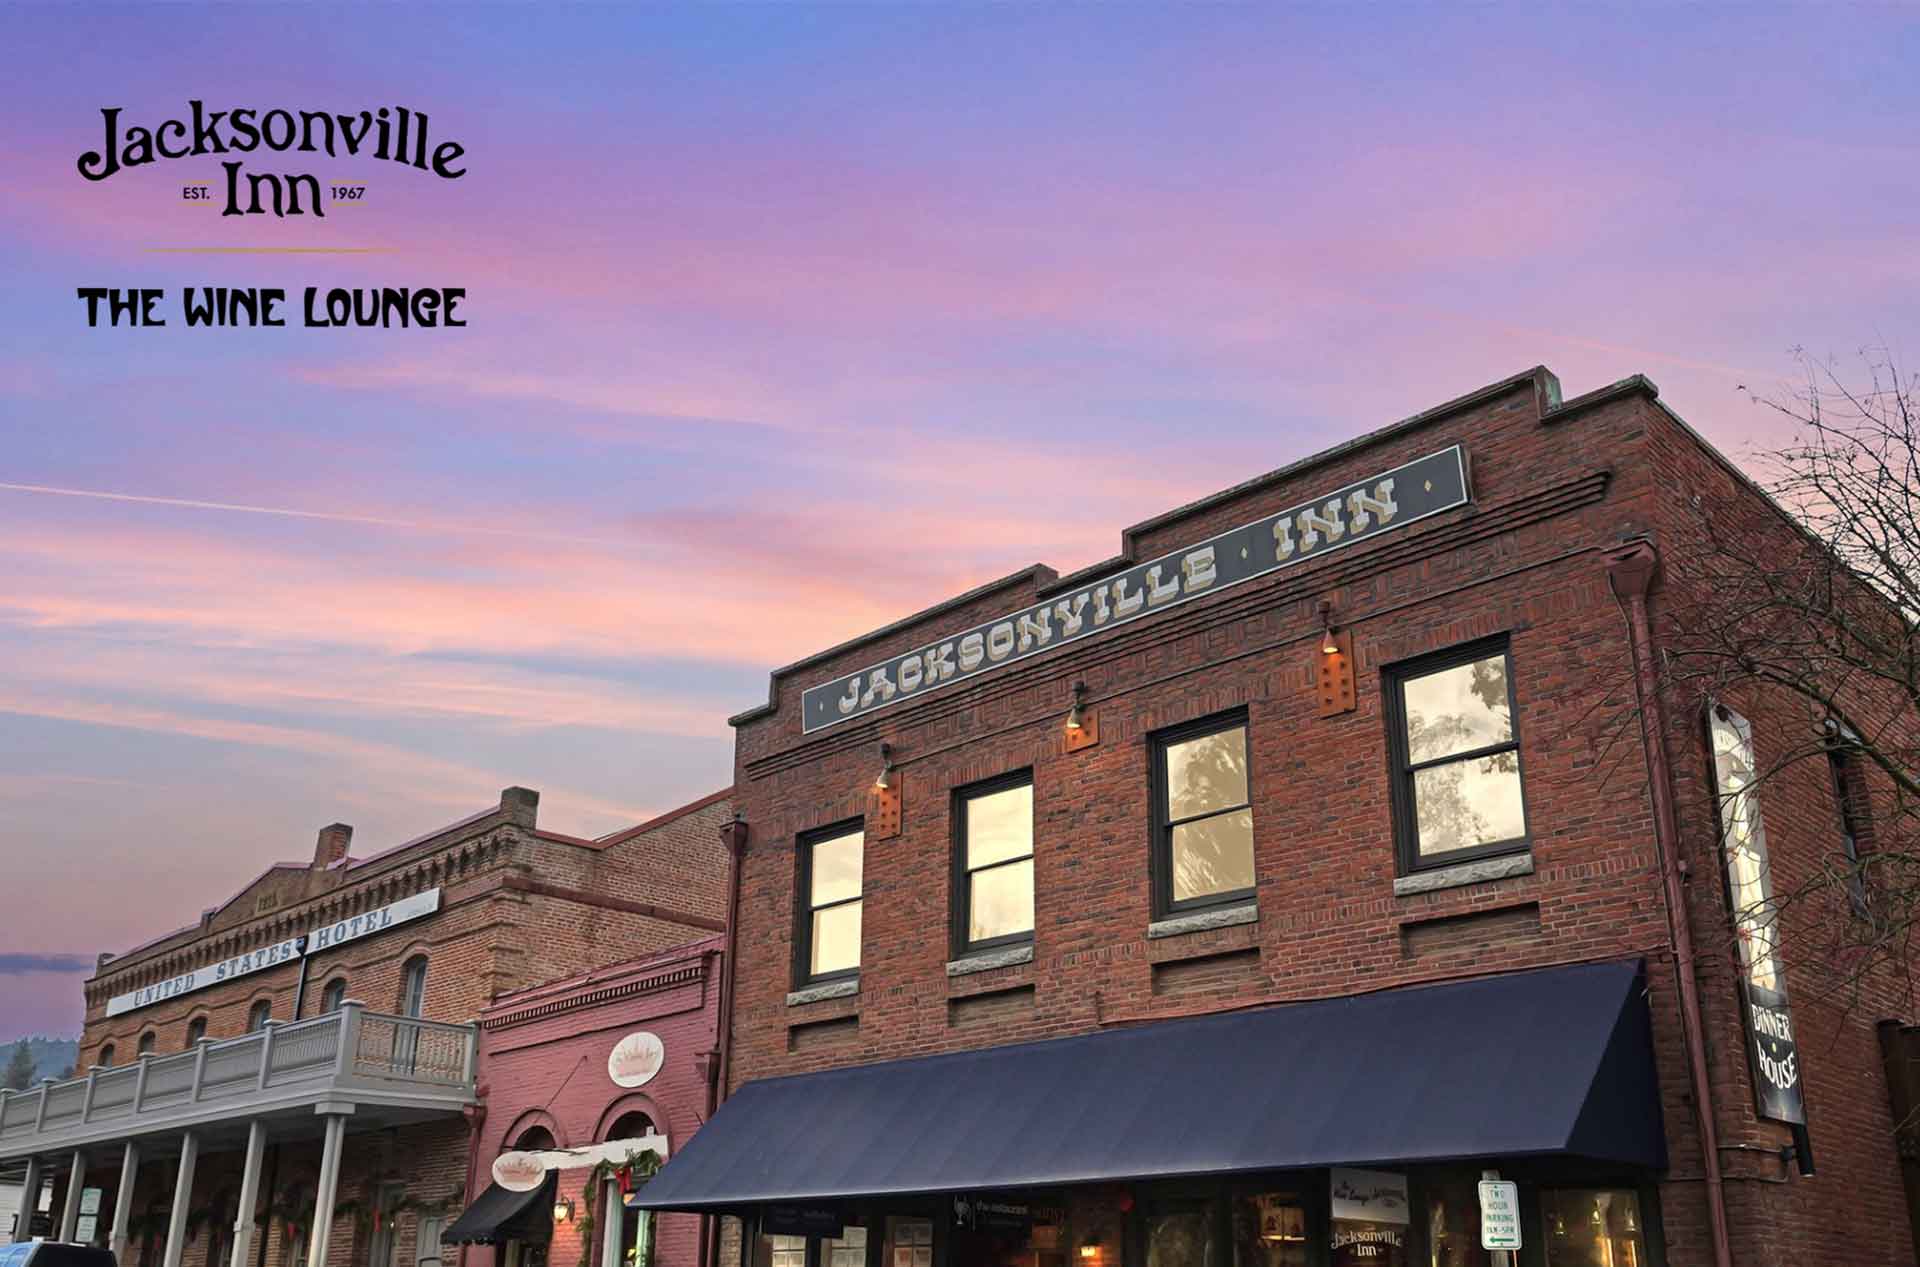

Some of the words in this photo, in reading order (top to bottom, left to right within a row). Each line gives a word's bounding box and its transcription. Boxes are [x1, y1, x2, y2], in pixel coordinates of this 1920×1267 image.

[838, 545, 1217, 714] JACKSONVILLE
[1272, 477, 1399, 561] INN
[134, 973, 196, 1007] UNITED
[216, 942, 292, 980] STATES
[315, 906, 393, 949] HOTEL
[1751, 1003, 1793, 1042] DINNER
[1756, 1038, 1798, 1090] HOUSE
[1330, 1230, 1402, 1250] Jacksonville
[1356, 1243, 1377, 1257] Inn
